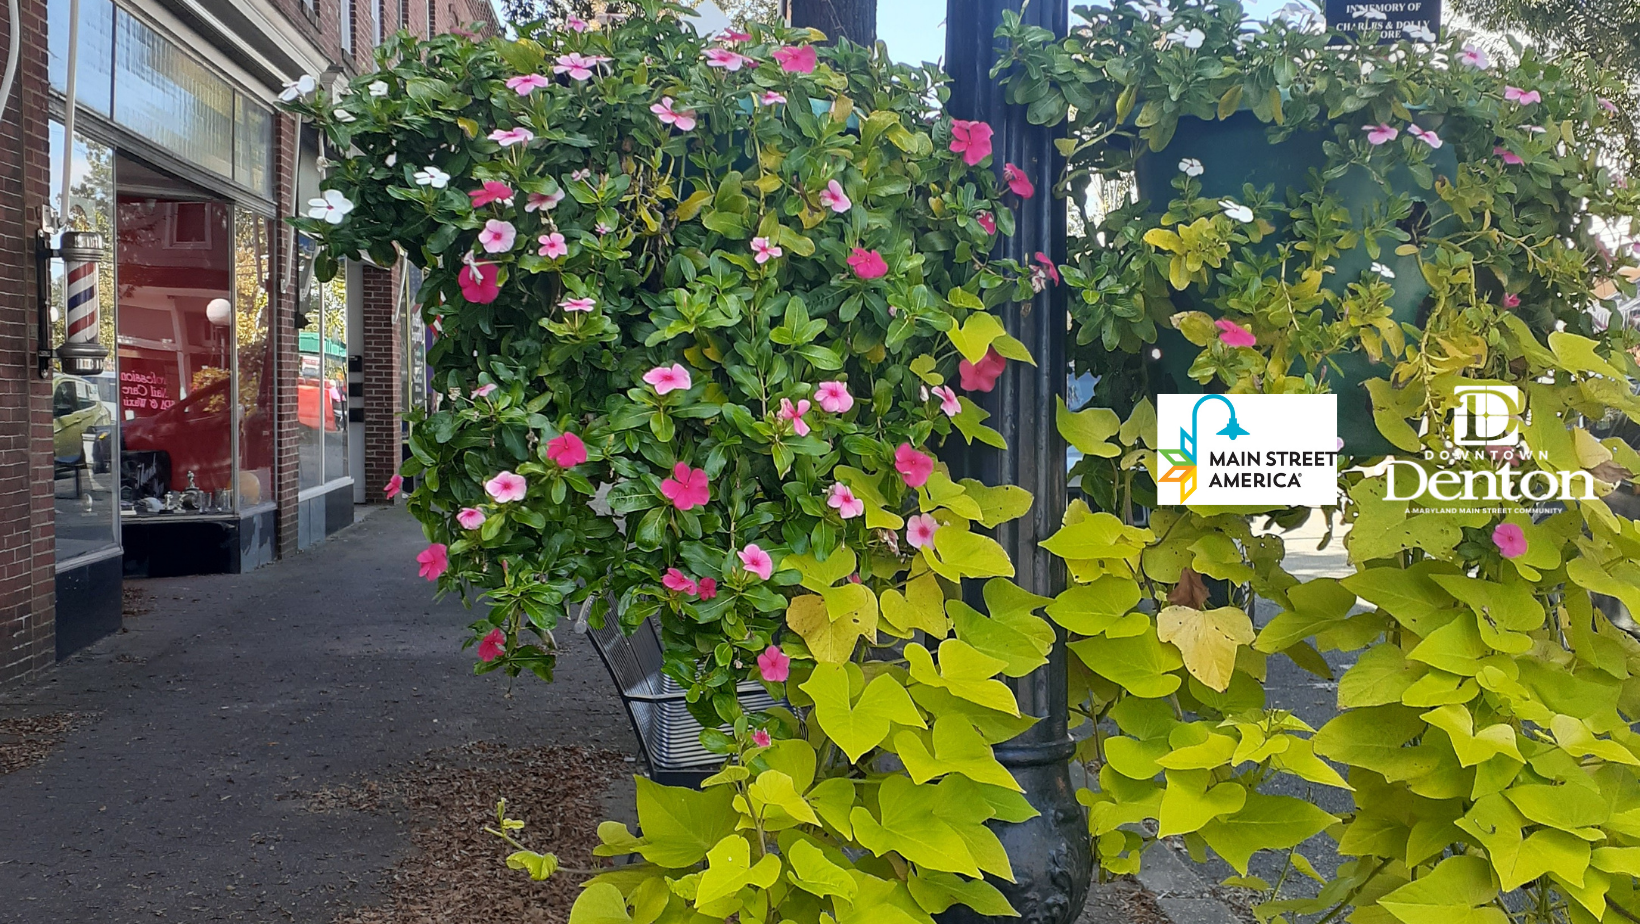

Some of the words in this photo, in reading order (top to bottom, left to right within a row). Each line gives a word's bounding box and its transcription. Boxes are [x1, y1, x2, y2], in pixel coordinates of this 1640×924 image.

[1346, 4, 1357, 14] IN
[1357, 3, 1405, 13] MEMORY
[1407, 2, 1422, 12] OF
[1336, 21, 1383, 31] CHARLES
[1385, 21, 1394, 30] &
